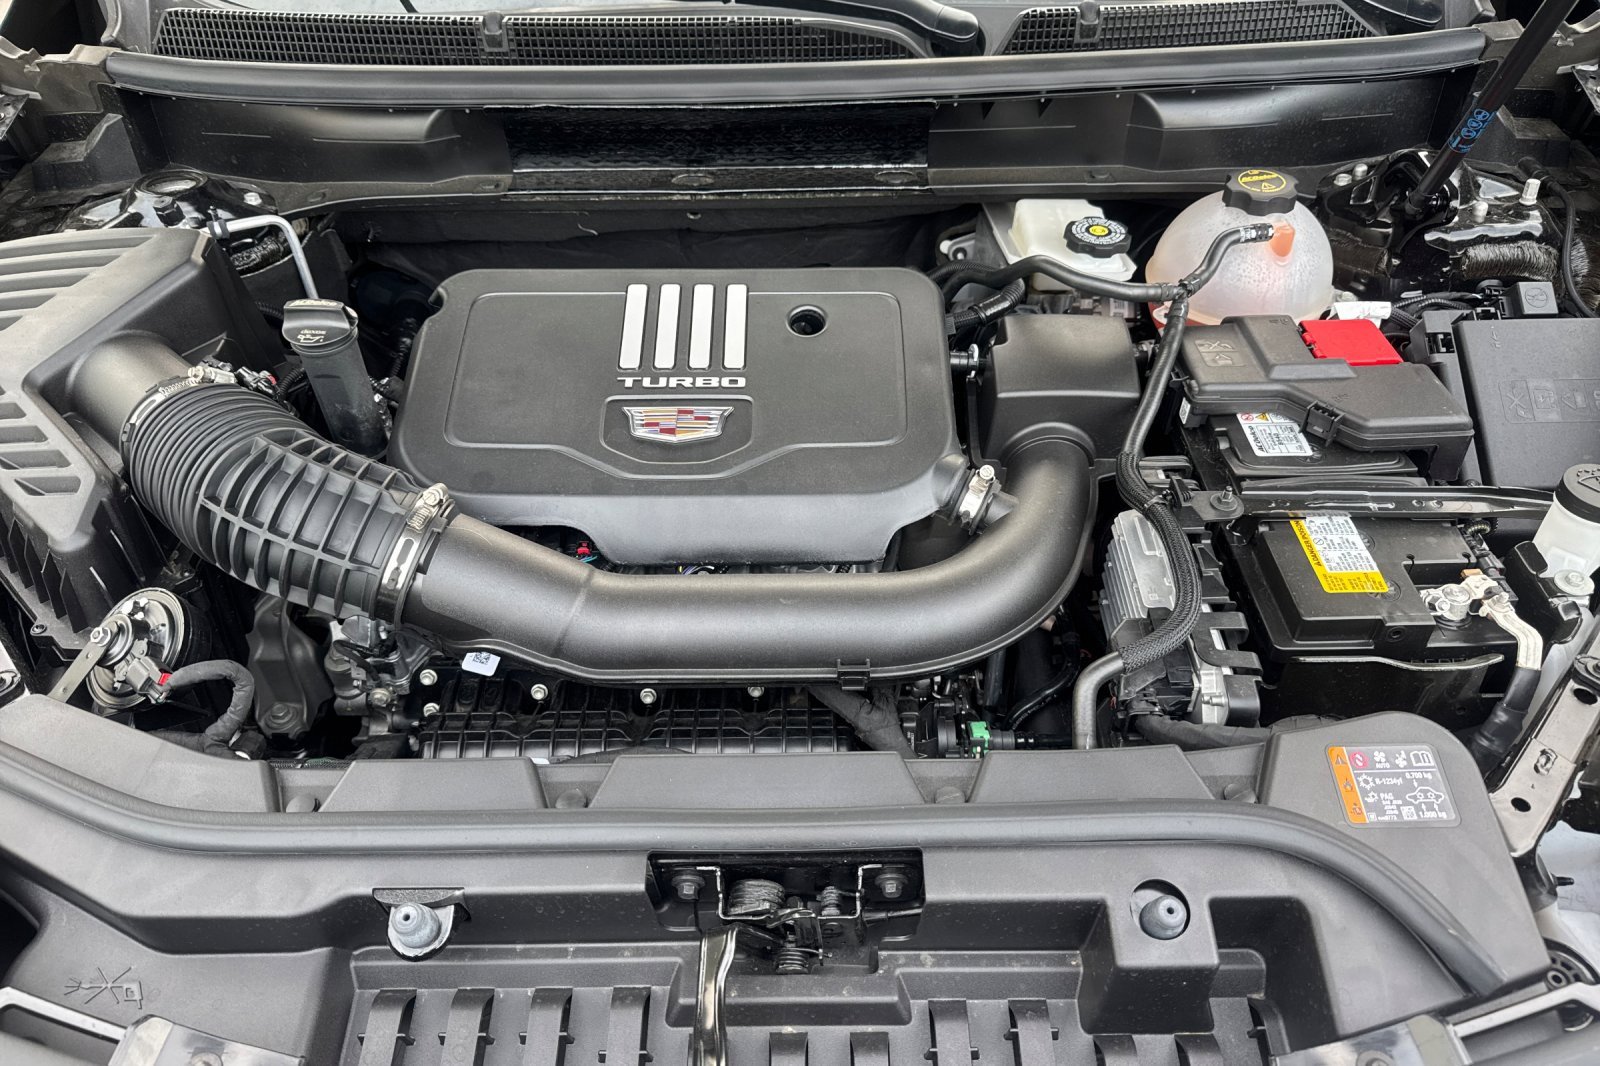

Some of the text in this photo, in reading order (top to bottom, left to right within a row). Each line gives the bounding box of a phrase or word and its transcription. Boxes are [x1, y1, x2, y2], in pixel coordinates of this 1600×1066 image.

[617, 376, 746, 388] TURBO
[1304, 540, 1319, 562] DANGER
[1423, 772, 1433, 780] kg
[1375, 777, 1403, 786] R-1234yf
[1379, 792, 1394, 801] PAG
